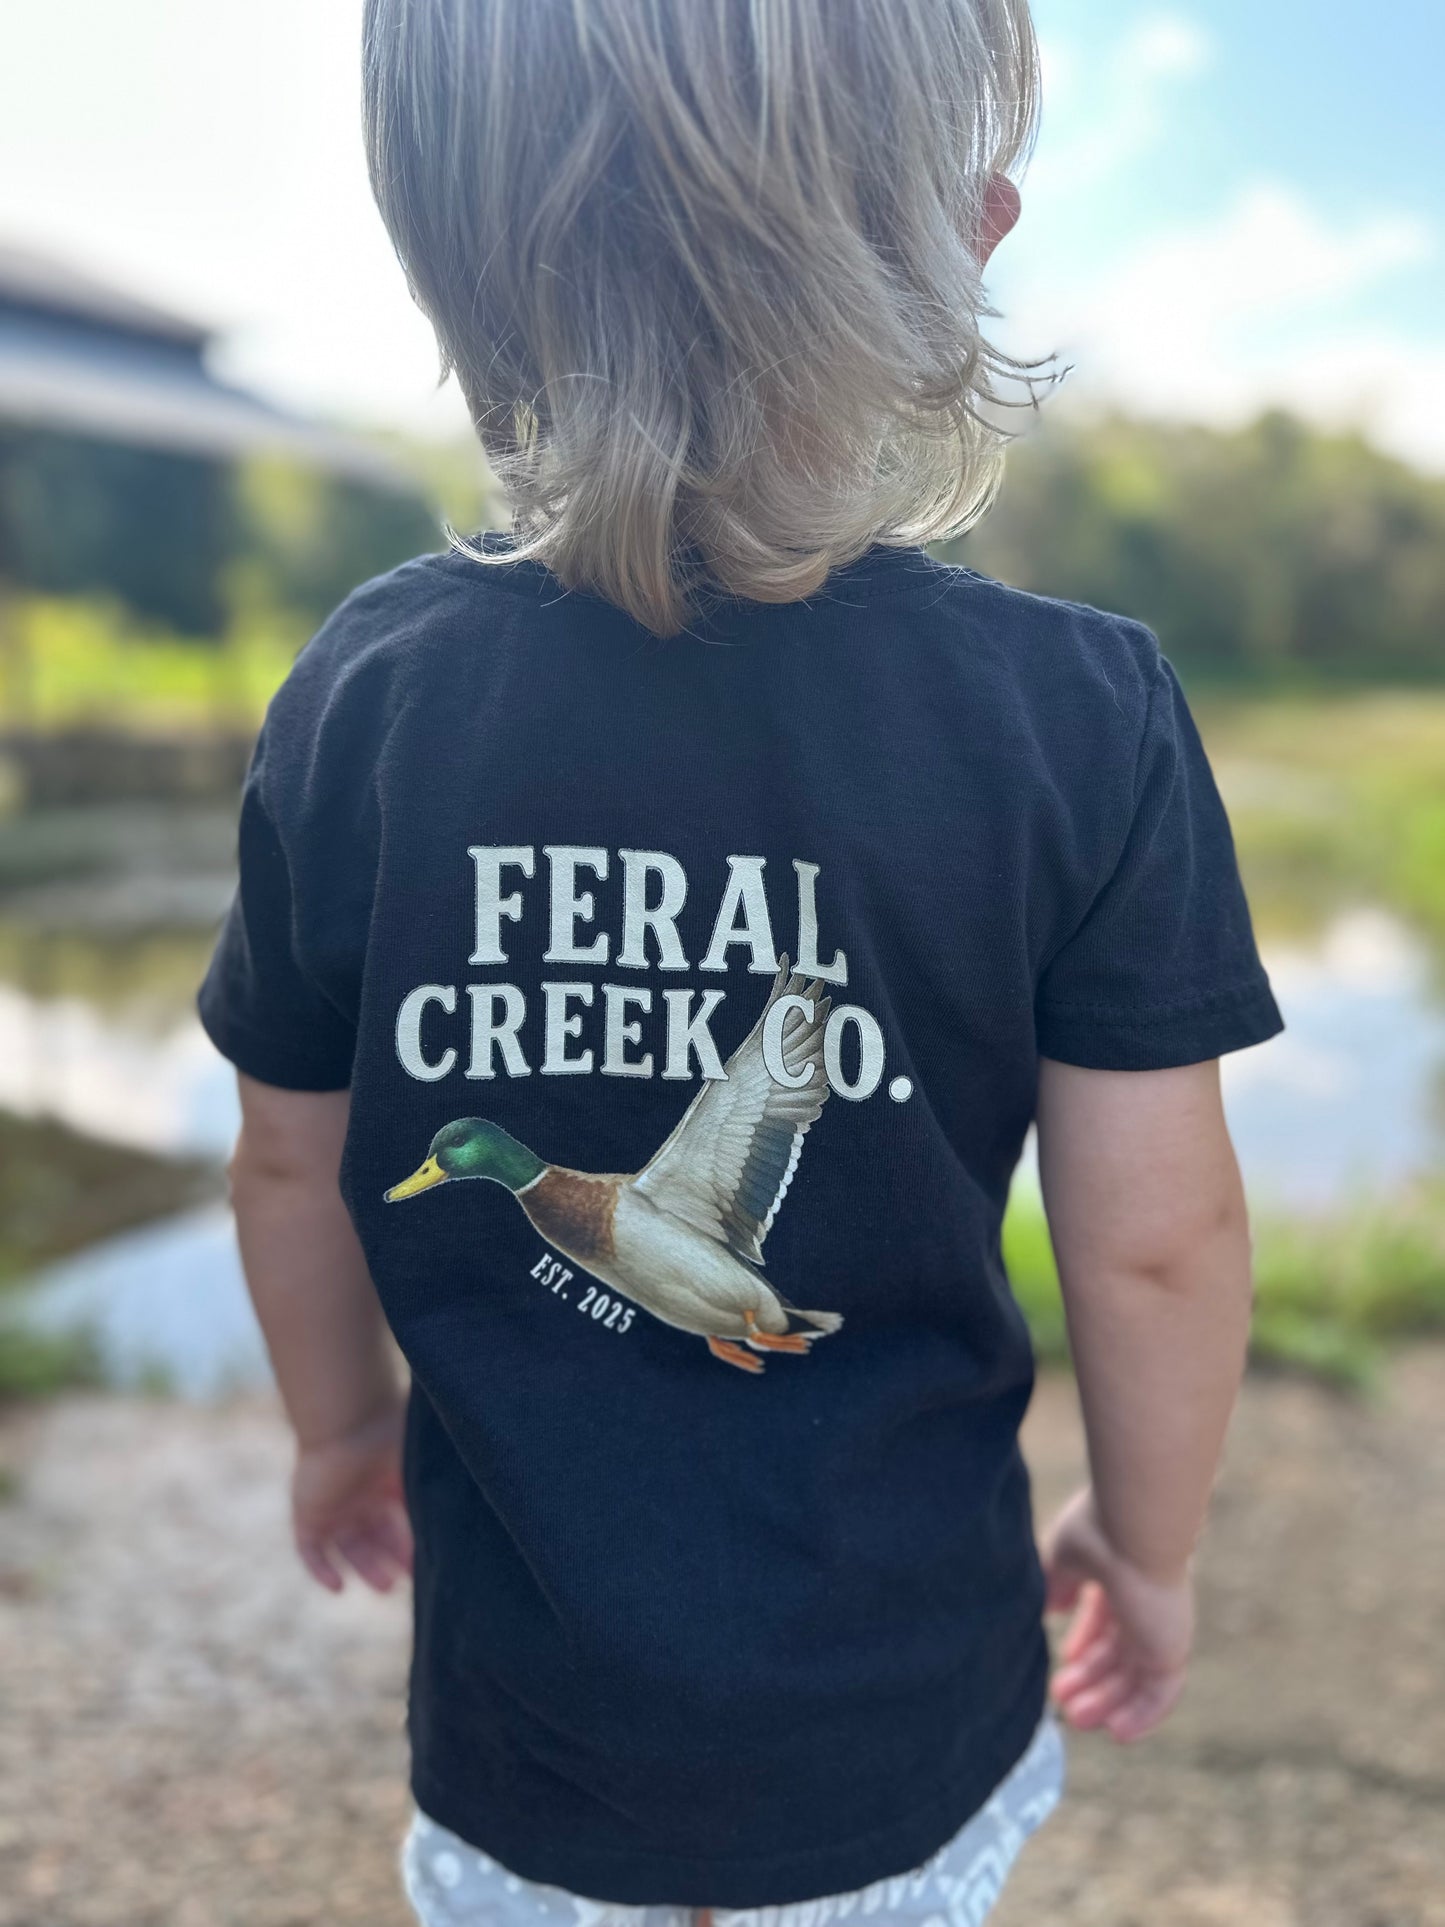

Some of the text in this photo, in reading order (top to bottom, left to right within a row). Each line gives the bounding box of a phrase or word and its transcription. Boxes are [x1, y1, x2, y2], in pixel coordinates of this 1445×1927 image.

[467, 846, 848, 985] FERAL
[396, 982, 913, 1101] CREEK CO.
[530, 1253, 636, 1334] EST. 2025
